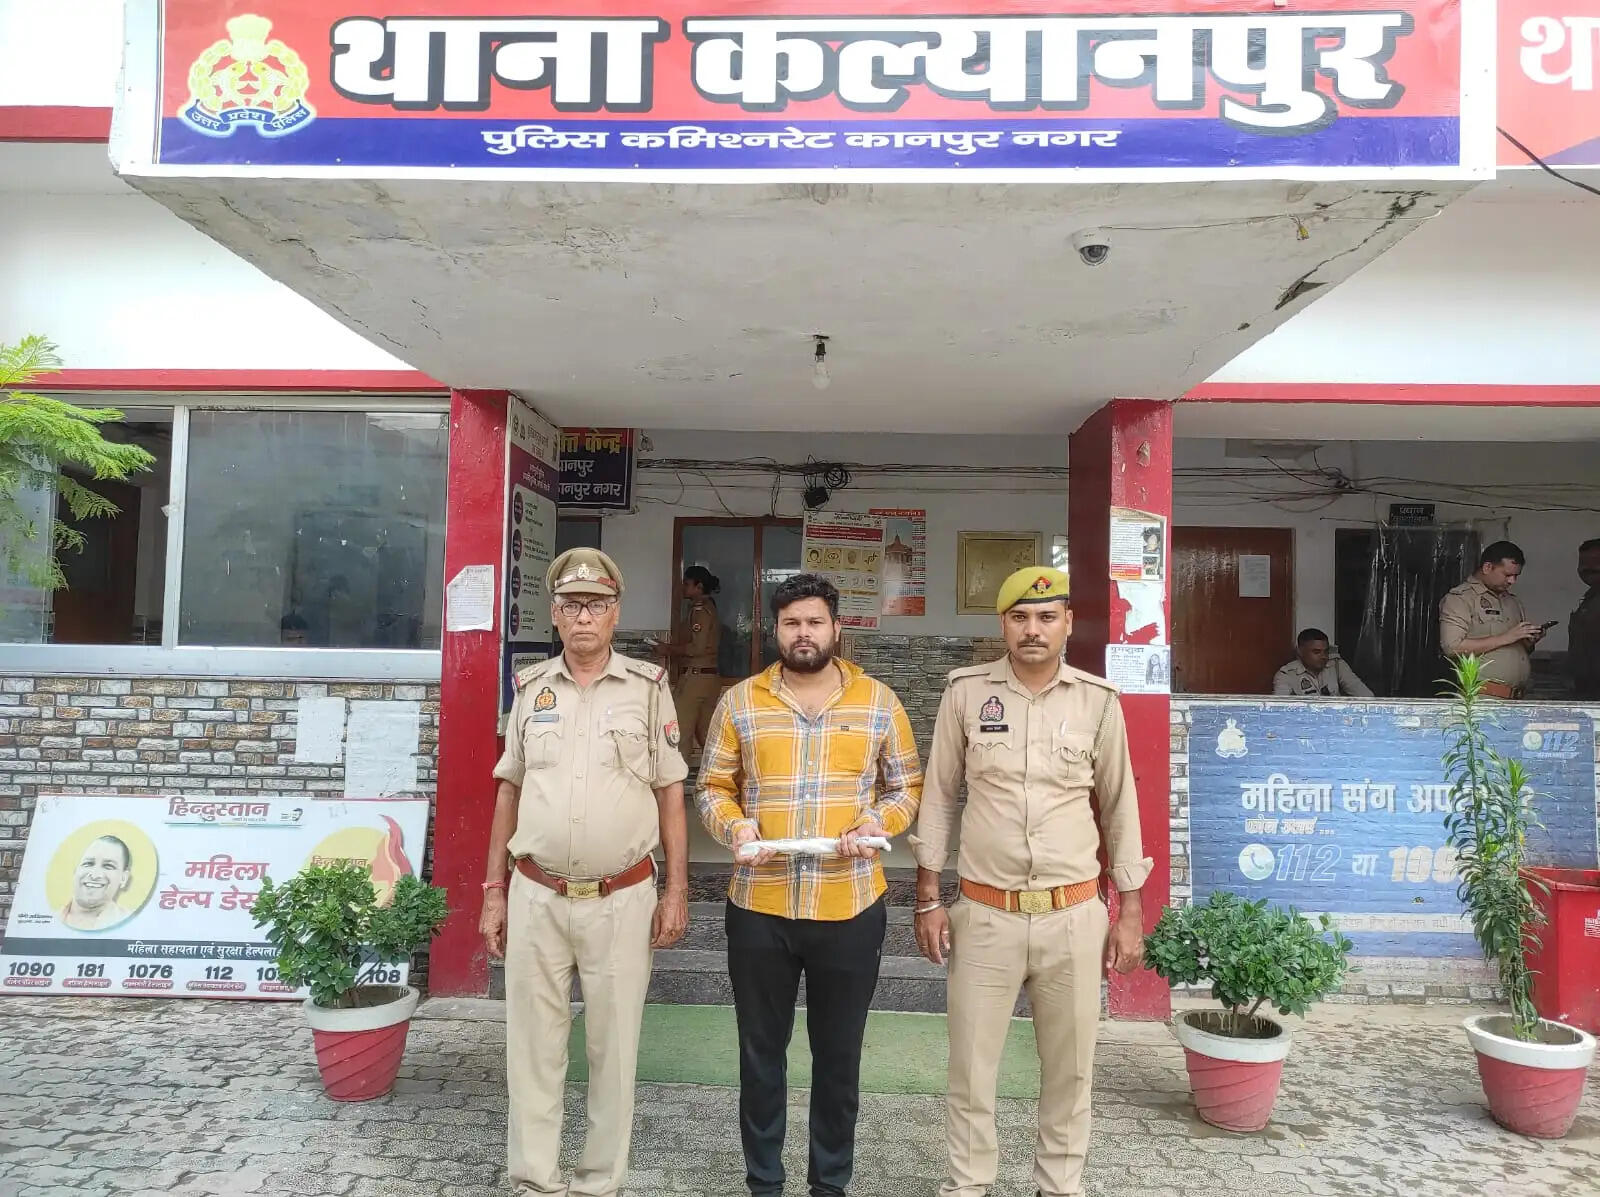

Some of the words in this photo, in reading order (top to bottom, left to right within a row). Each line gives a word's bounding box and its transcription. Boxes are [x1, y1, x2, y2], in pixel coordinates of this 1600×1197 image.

[1520, 16, 1600, 91] थ
[331, 17, 668, 111] थाना
[685, 12, 1412, 131] कल्यानपुर
[227, 108, 267, 121] प्रदेश
[481, 125, 609, 154] पुलिस
[620, 126, 836, 149] कमिश्नरेट
[844, 131, 1004, 155] कानपुर
[1012, 130, 1122, 147] नगर
[593, 484, 622, 496] नगर
[1240, 773, 1333, 814] महिला
[1341, 778, 1396, 813] संग
[168, 796, 270, 822] हिन्दुस्तान
[185, 854, 270, 880] महिला
[1276, 844, 1341, 881] 112
[1352, 854, 1378, 877] या
[1389, 845, 1462, 883] 109
[159, 884, 214, 909] हेल्प
[127, 941, 158, 955] महिला
[161, 944, 198, 956] सहायता
[200, 943, 214, 958] एवं
[217, 945, 242, 959] सुरक्षा
[9, 962, 55, 976] 1090
[77, 963, 105, 977] 181
[128, 964, 173, 978] 1076
[205, 966, 233, 979] 112
